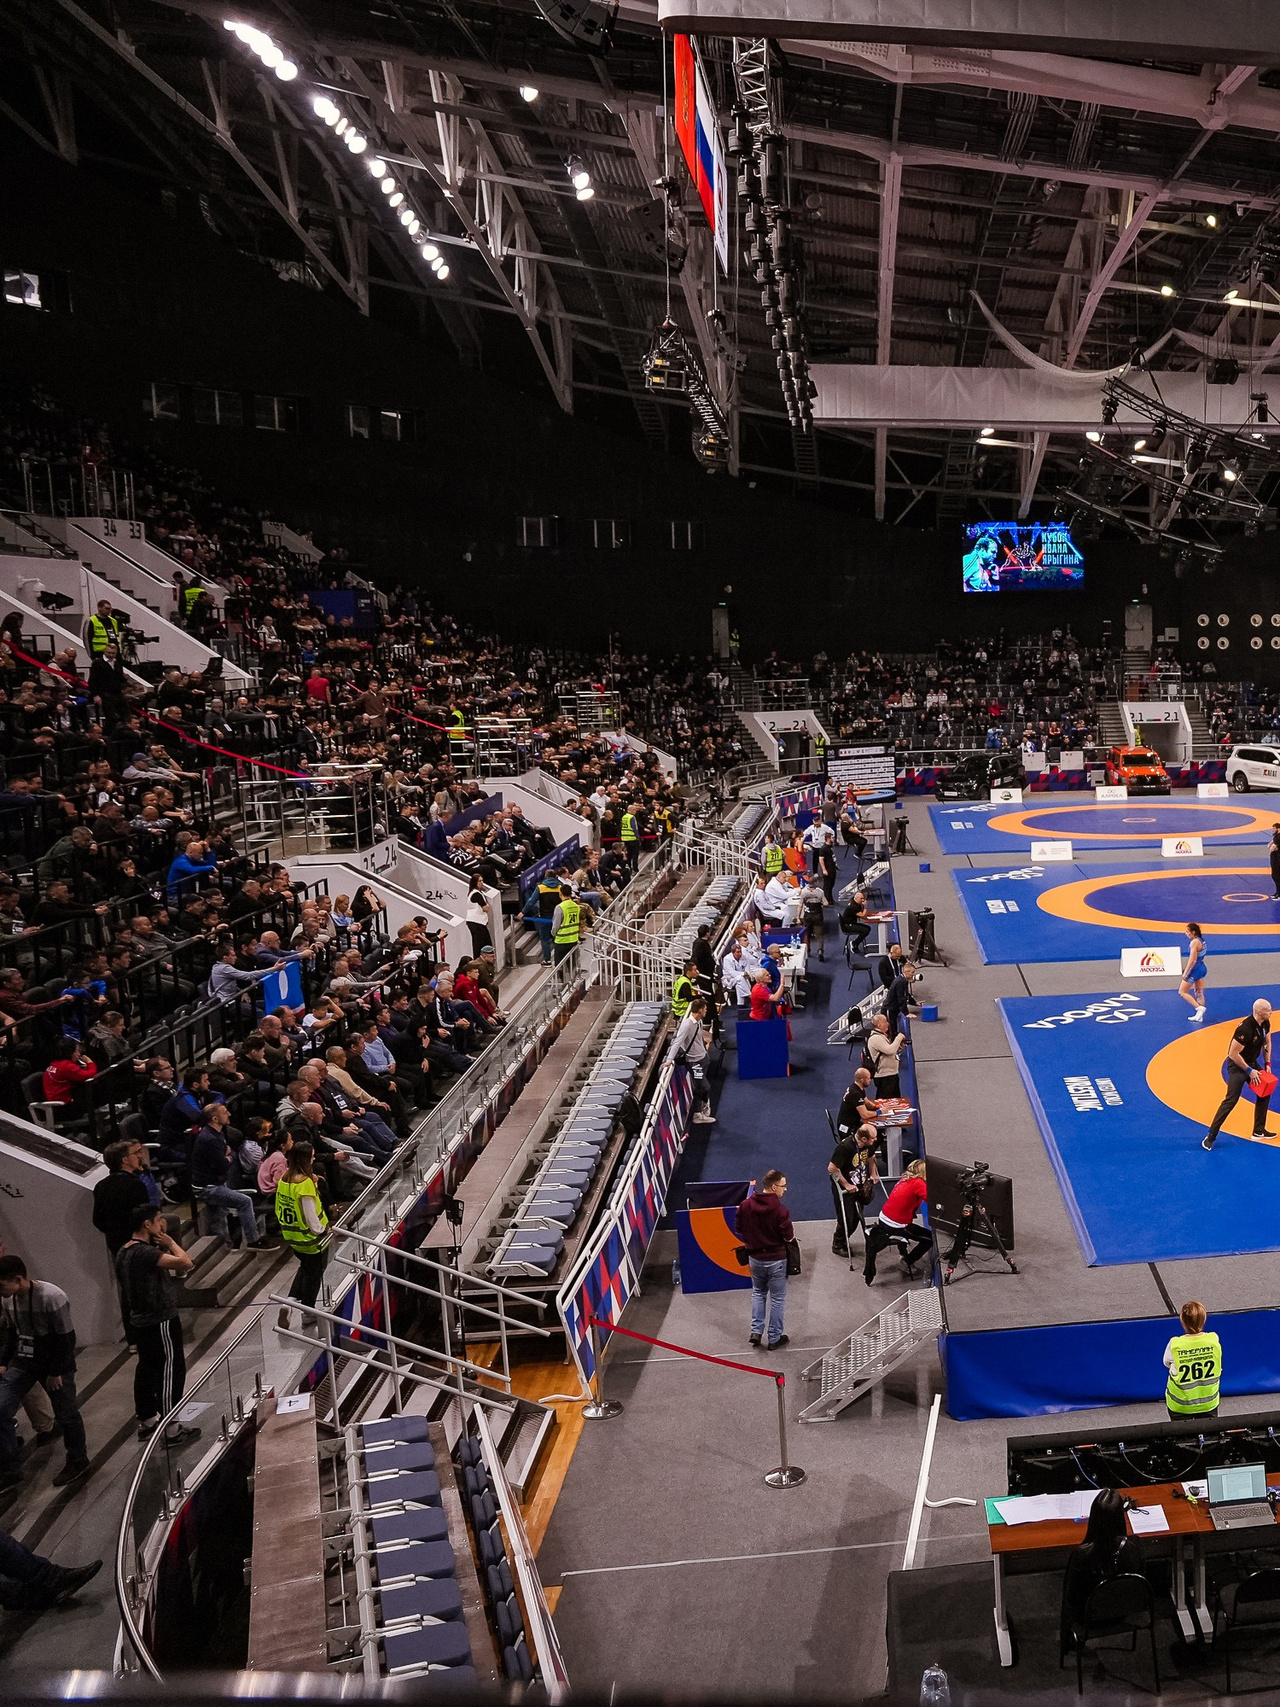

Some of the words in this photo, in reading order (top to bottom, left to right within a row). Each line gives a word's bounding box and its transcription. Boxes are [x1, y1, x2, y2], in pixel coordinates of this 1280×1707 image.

[1042, 543, 1068, 553] ИВАНА
[1042, 554, 1079, 564] ЯРЫГИНА
[1164, 712, 1179, 721] 2.1
[425, 890, 443, 900] 2.4
[1179, 1360, 1215, 1383] 262
